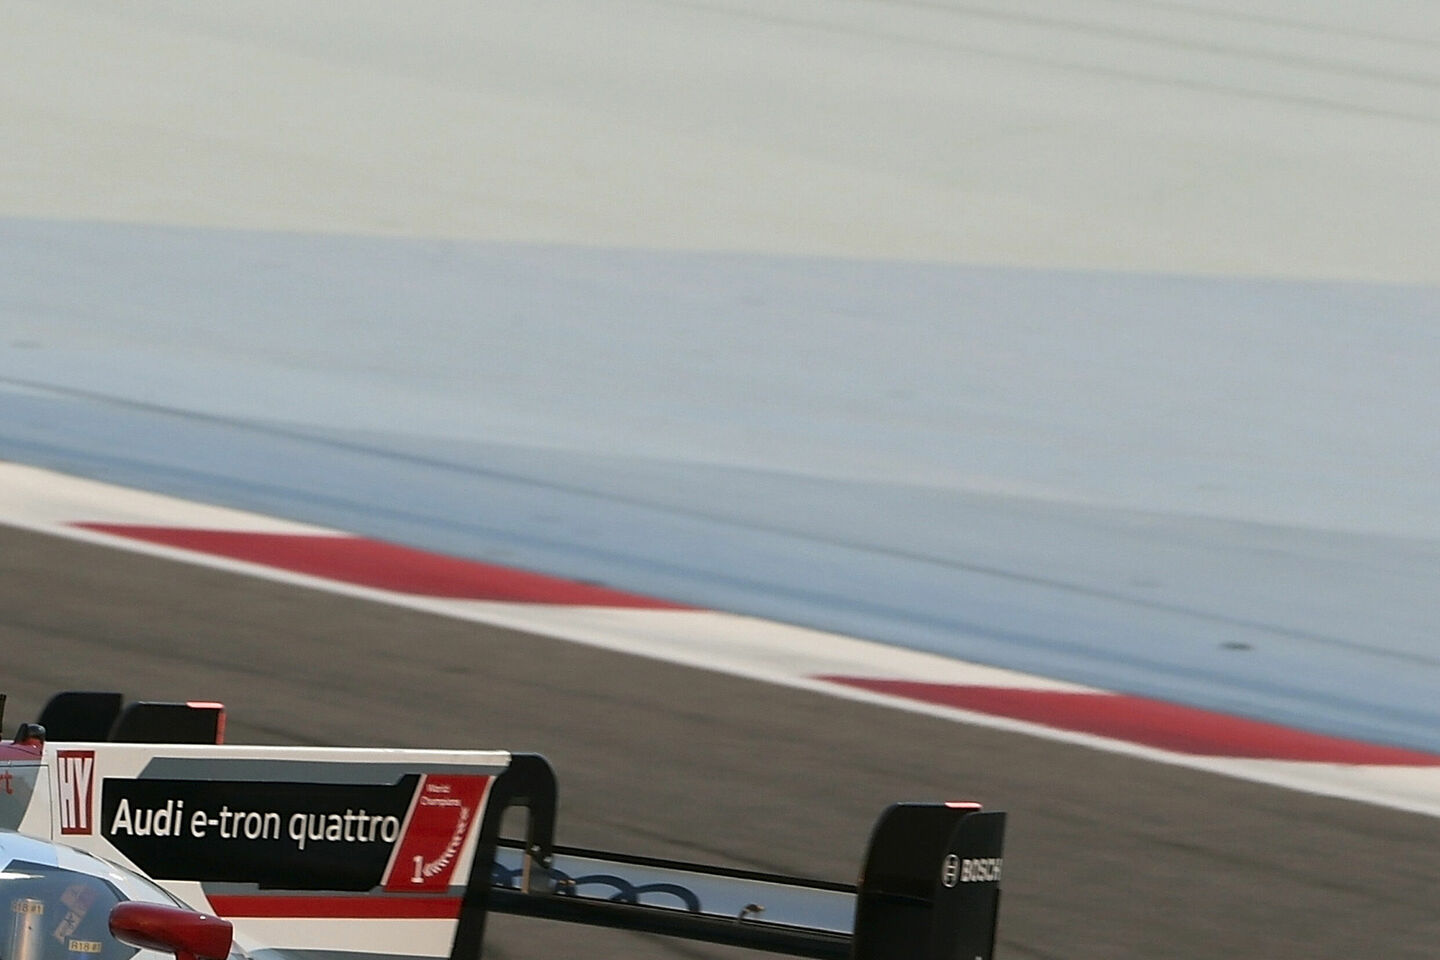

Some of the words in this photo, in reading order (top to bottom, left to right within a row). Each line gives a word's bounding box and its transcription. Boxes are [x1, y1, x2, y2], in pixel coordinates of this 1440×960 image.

[59, 757, 93, 829] HY
[110, 798, 184, 836] Audi
[190, 805, 281, 839] e-tron
[288, 809, 400, 850] quattro
[961, 858, 1002, 882] BOSCH
